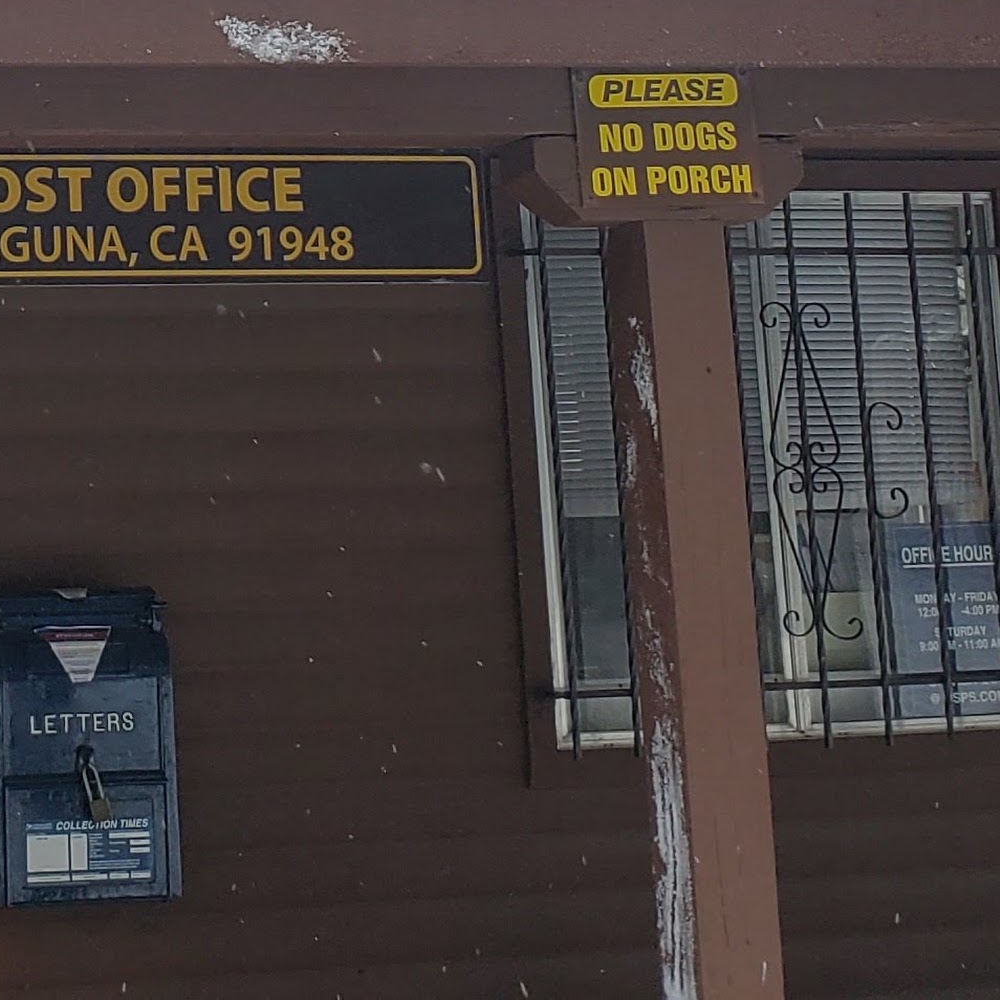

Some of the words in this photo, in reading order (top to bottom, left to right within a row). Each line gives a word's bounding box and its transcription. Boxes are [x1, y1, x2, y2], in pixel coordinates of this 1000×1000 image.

[603, 79, 724, 102] PLEASE
[599, 123, 643, 153] NO
[653, 121, 737, 152] DOGS
[106, 166, 304, 213] OFFICE
[592, 167, 637, 196] ON
[647, 164, 753, 195] PORCH
[150, 225, 208, 262] CA
[228, 225, 354, 261] 91948
[901, 545, 952, 564] OFFIE
[914, 592, 956, 604] MONAY
[934, 625, 986, 638] STURDAY
[29, 711, 134, 735] LETTERS
[120, 818, 149, 828] TIMES
